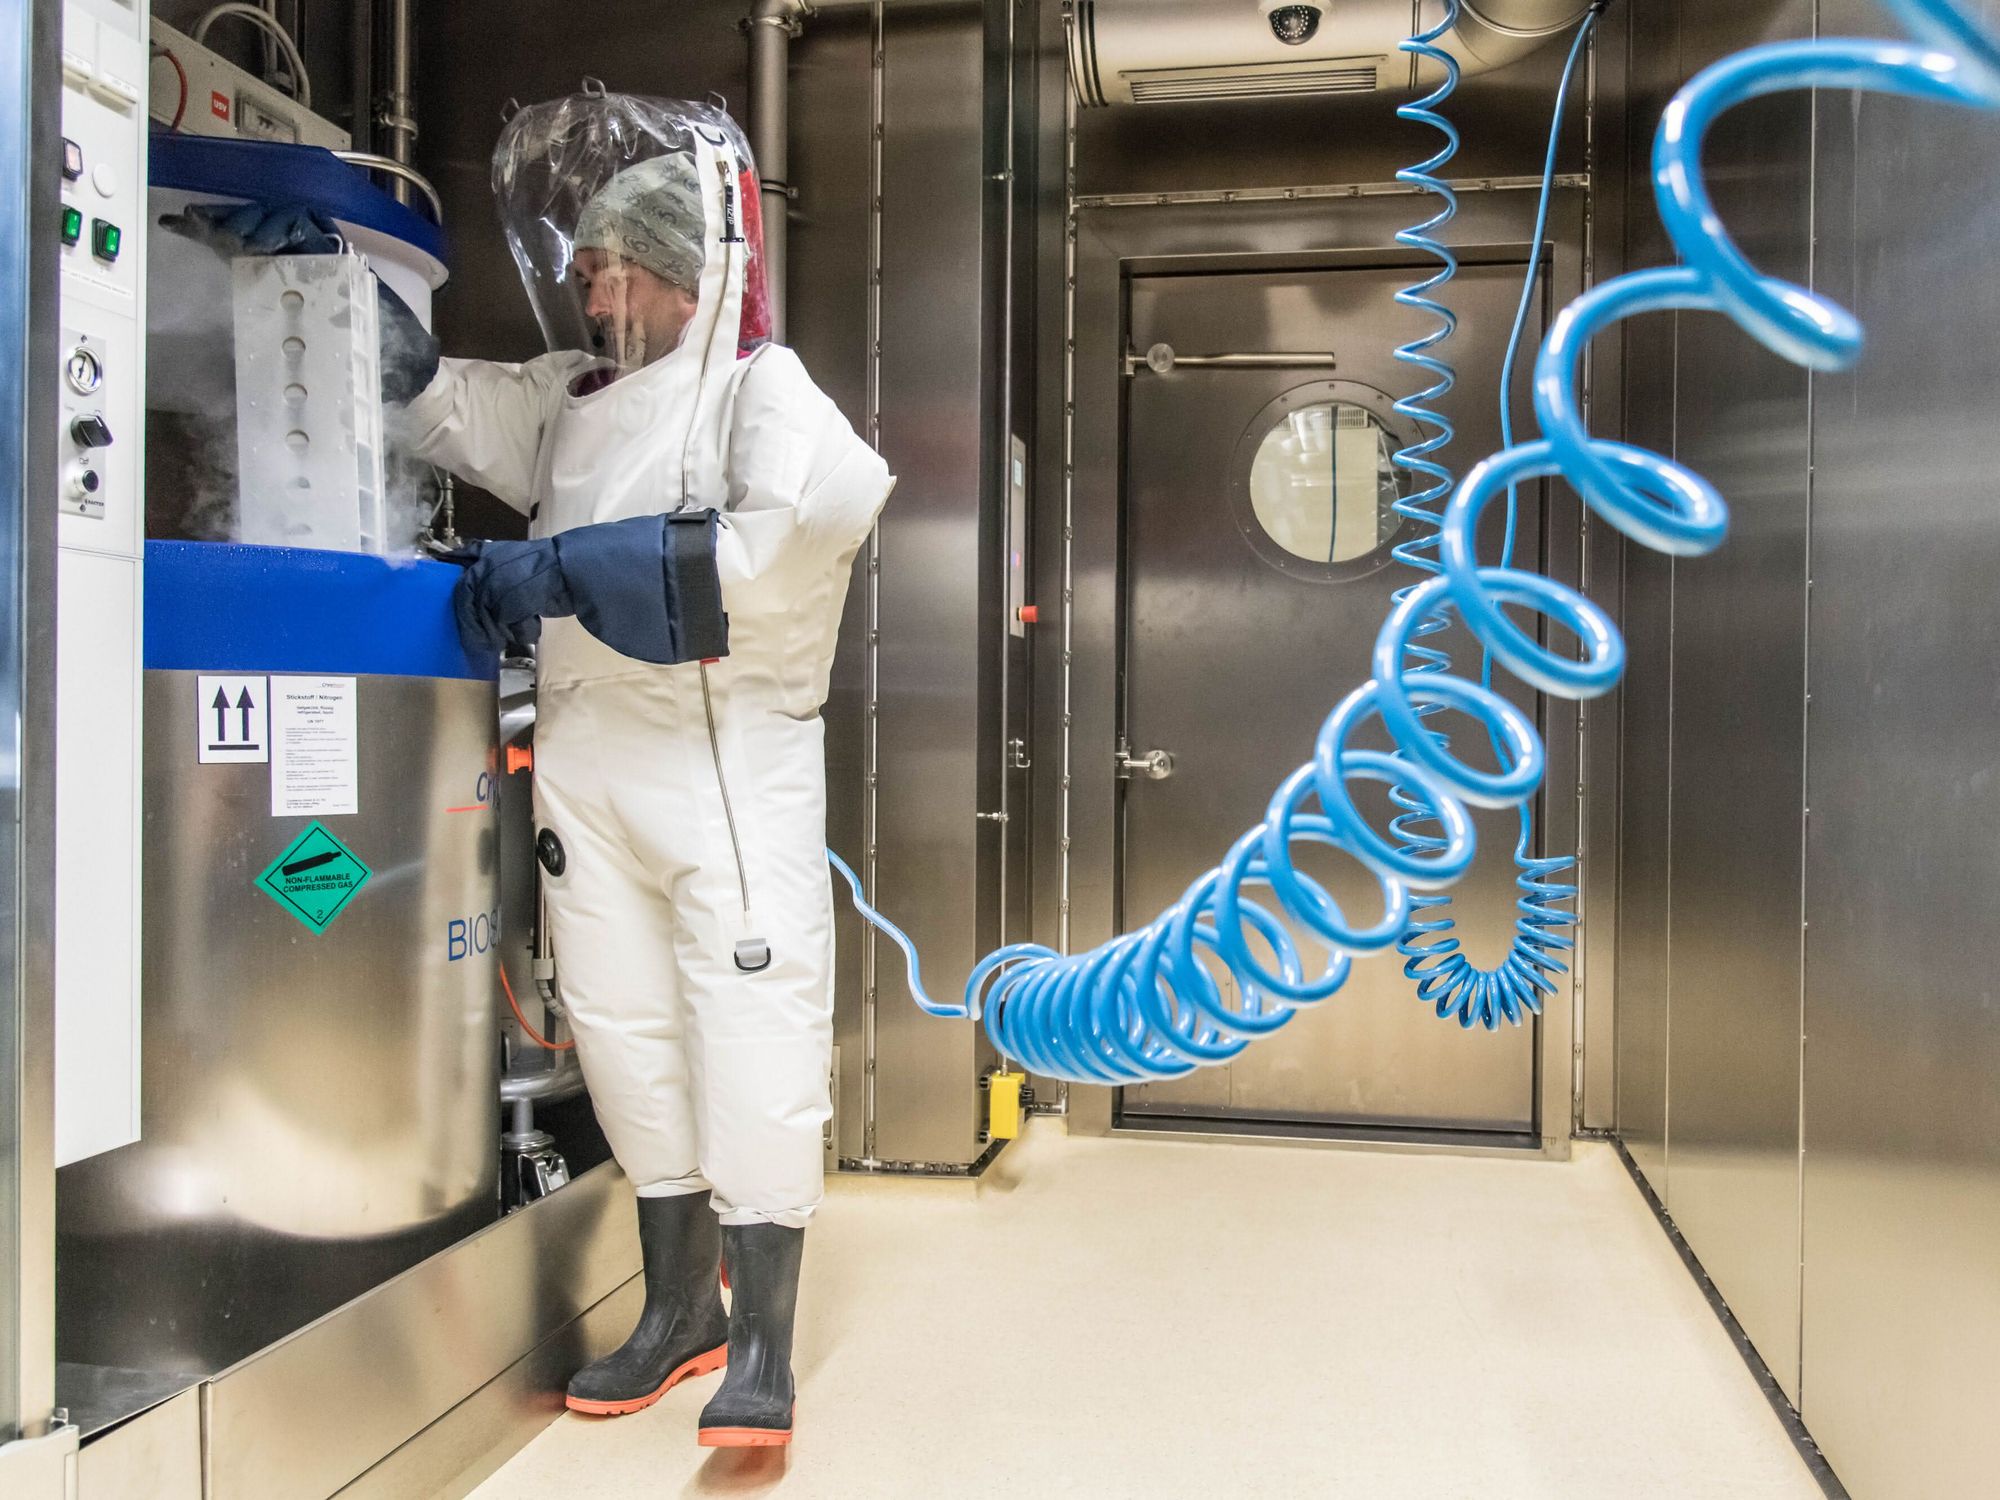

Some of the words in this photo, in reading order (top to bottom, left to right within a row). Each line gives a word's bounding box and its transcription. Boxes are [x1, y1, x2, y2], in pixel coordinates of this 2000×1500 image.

[213, 98, 227, 112] USV
[285, 872, 351, 884] NON-FLAMMABLE
[283, 882, 336, 893] COMPRESSED
[338, 881, 353, 889] GAS
[316, 909, 324, 919] 2
